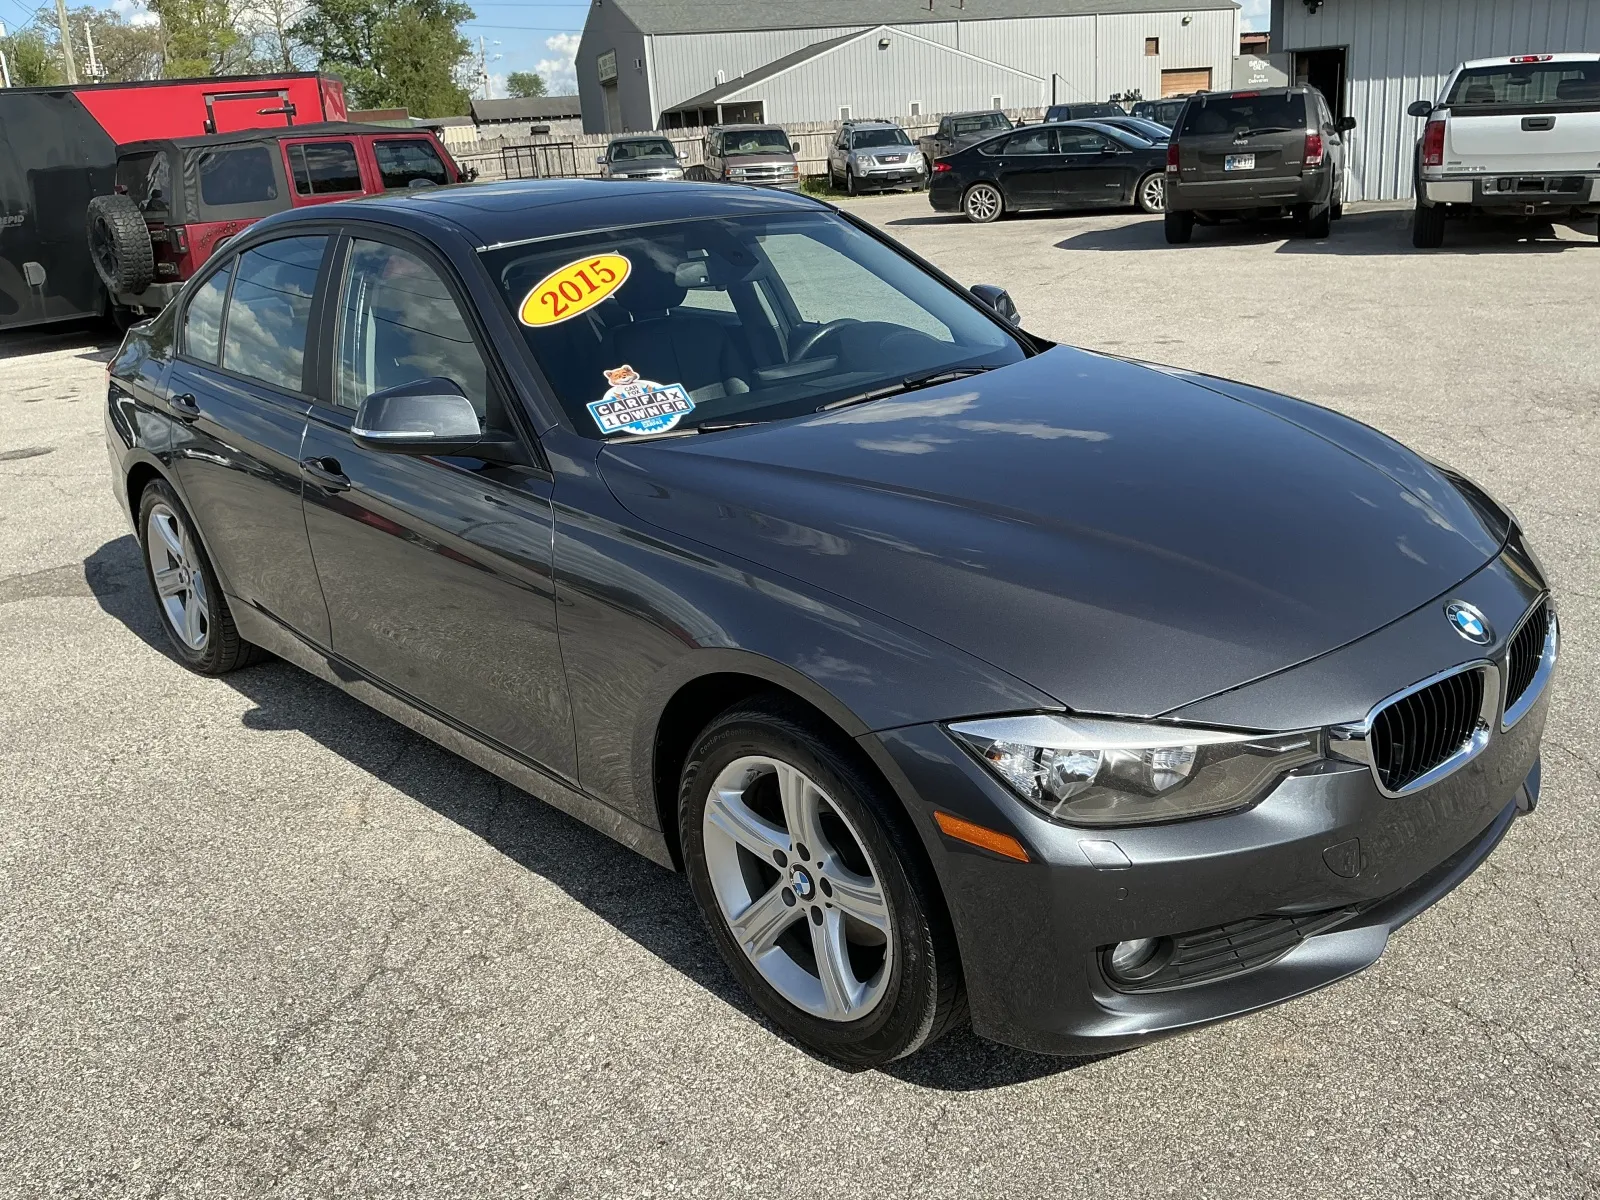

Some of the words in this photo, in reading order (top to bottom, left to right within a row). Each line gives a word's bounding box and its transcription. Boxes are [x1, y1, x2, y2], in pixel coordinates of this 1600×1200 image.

[541, 260, 616, 317] 2015
[598, 391, 681, 415] CARFAX
[605, 417, 616, 427] 1
[619, 401, 689, 424] OWNER
